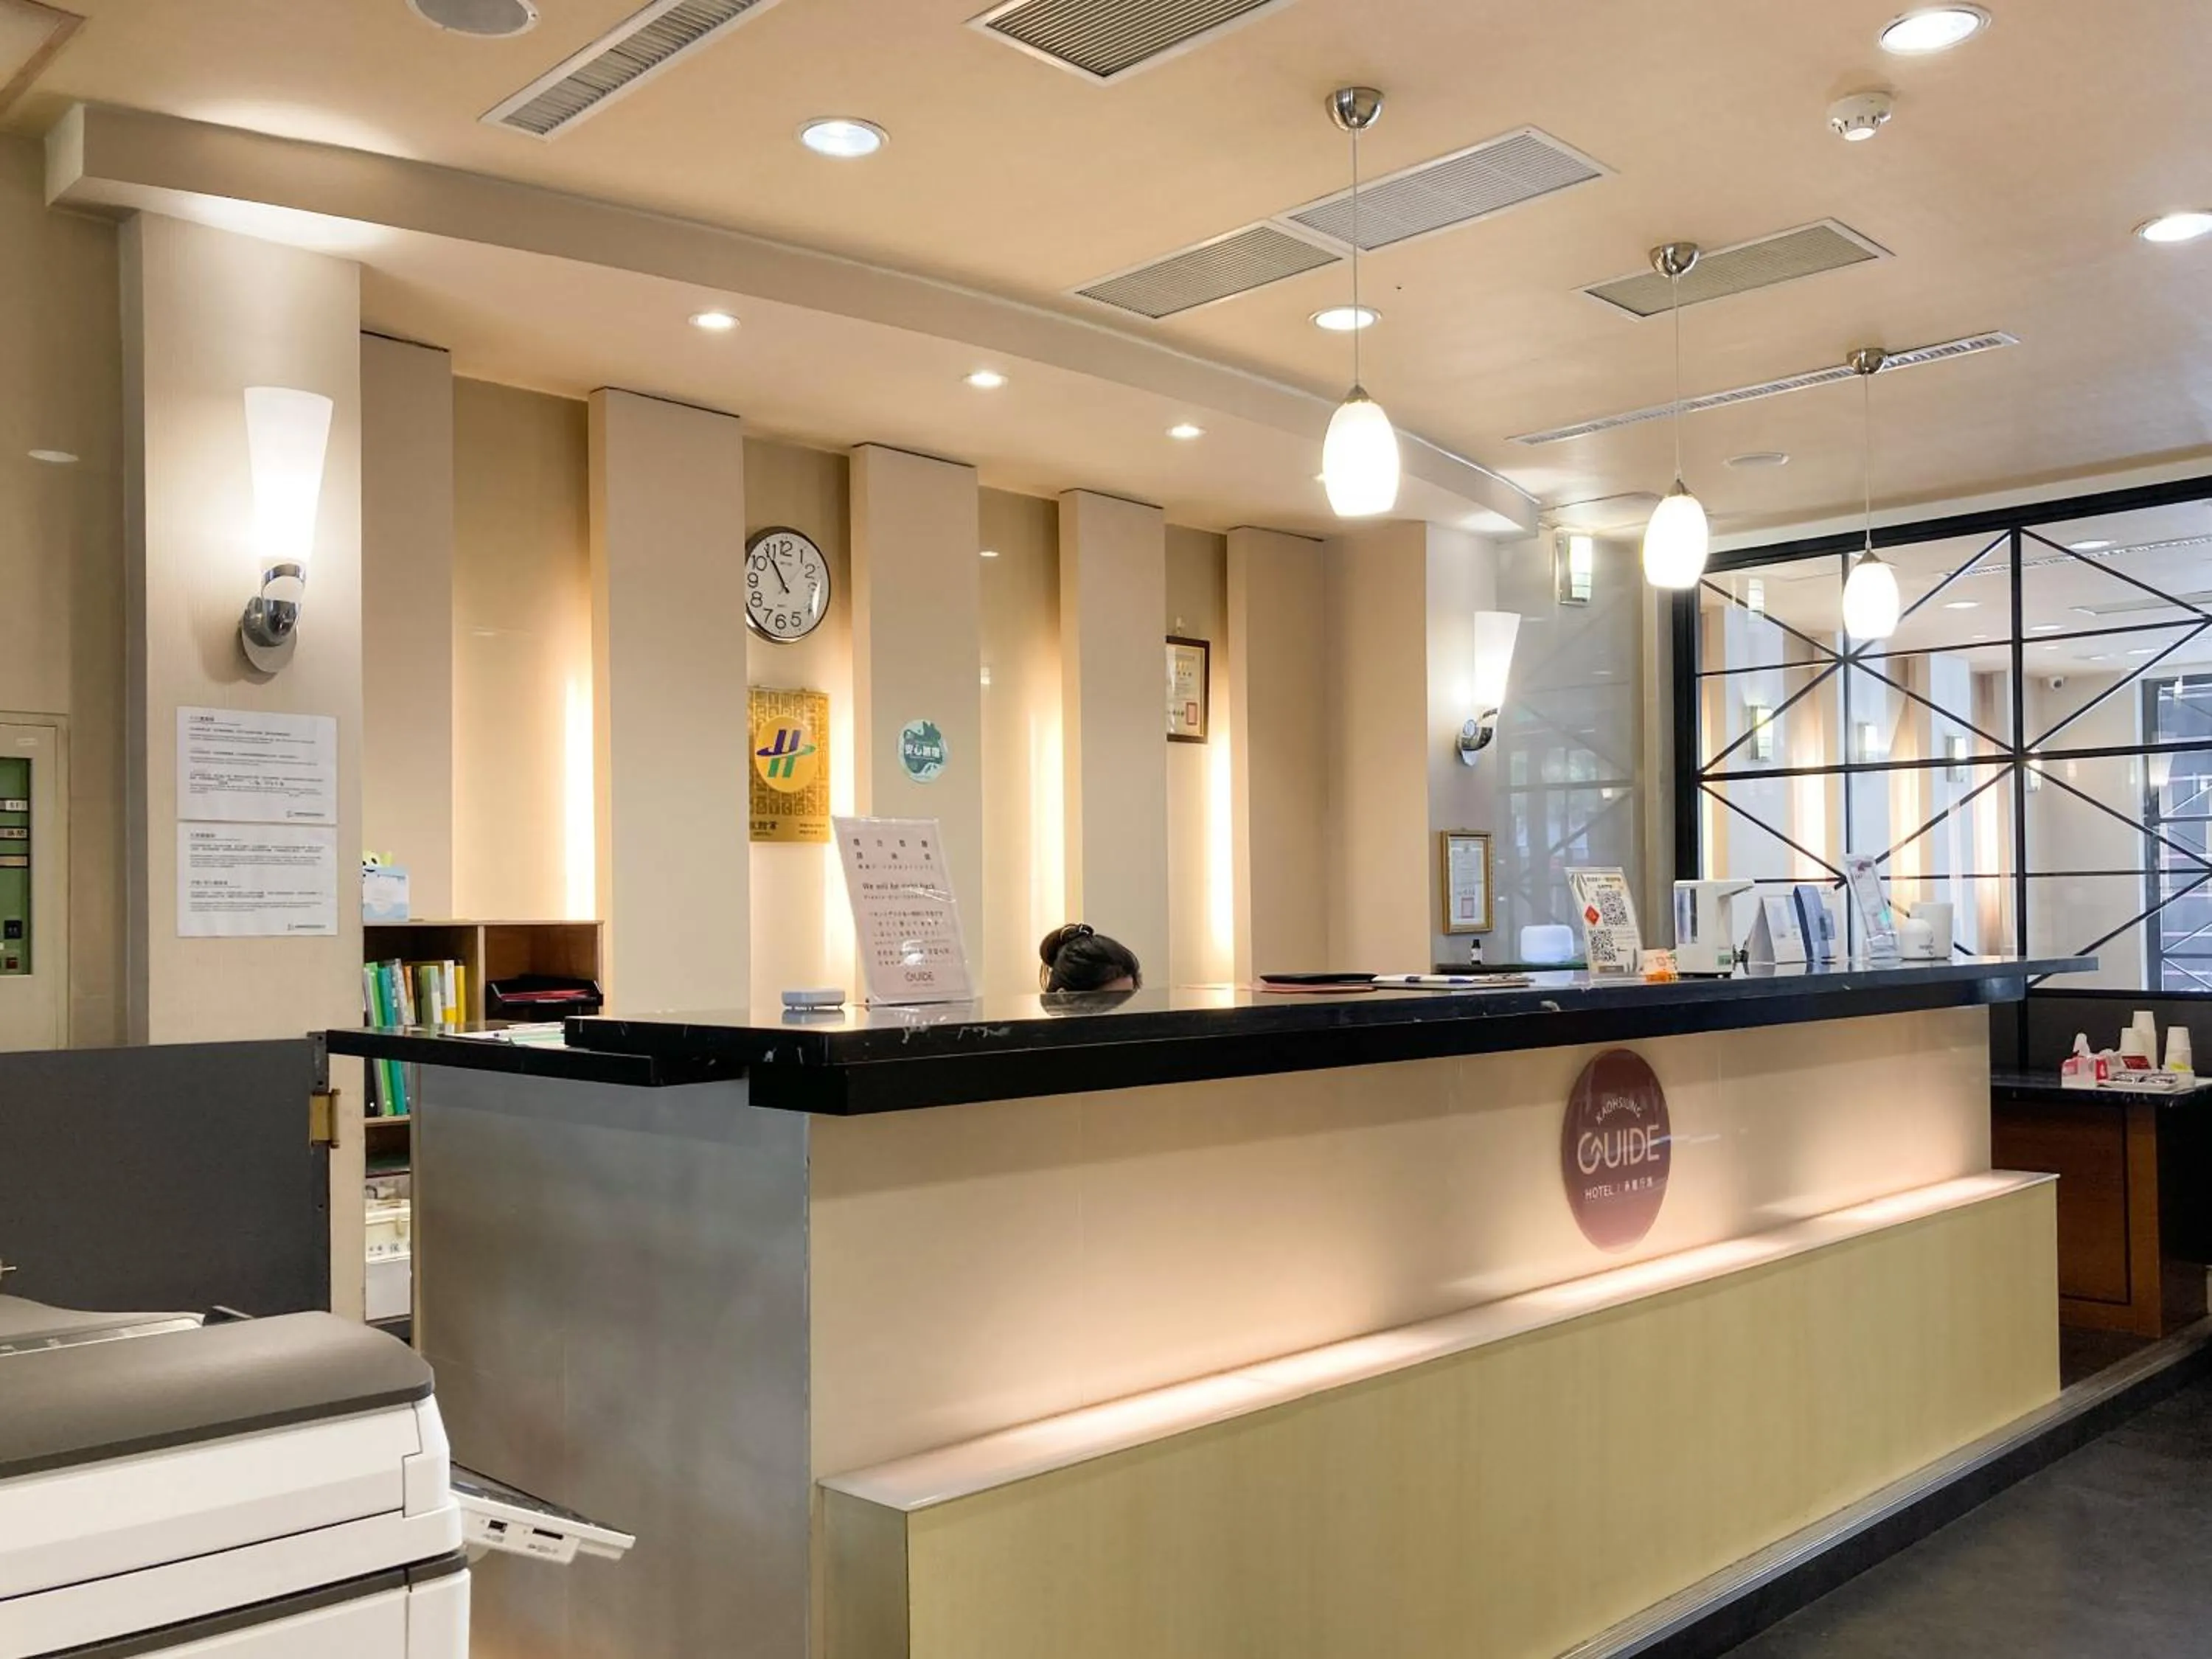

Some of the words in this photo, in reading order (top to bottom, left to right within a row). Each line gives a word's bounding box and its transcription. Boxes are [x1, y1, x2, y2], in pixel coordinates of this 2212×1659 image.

[764, 543, 776, 560] 11
[779, 540, 793, 557] 12
[799, 549, 804, 563] 1
[751, 554, 768, 571] 10
[804, 563, 815, 579] 2
[747, 572, 759, 588] 9
[750, 591, 763, 608] 8
[762, 608, 773, 624] 7
[775, 613, 787, 630] 6
[790, 611, 801, 627] 5
[1577, 1124, 1660, 1175] GUIDE
[1585, 1184, 1614, 1200] HOTEL
